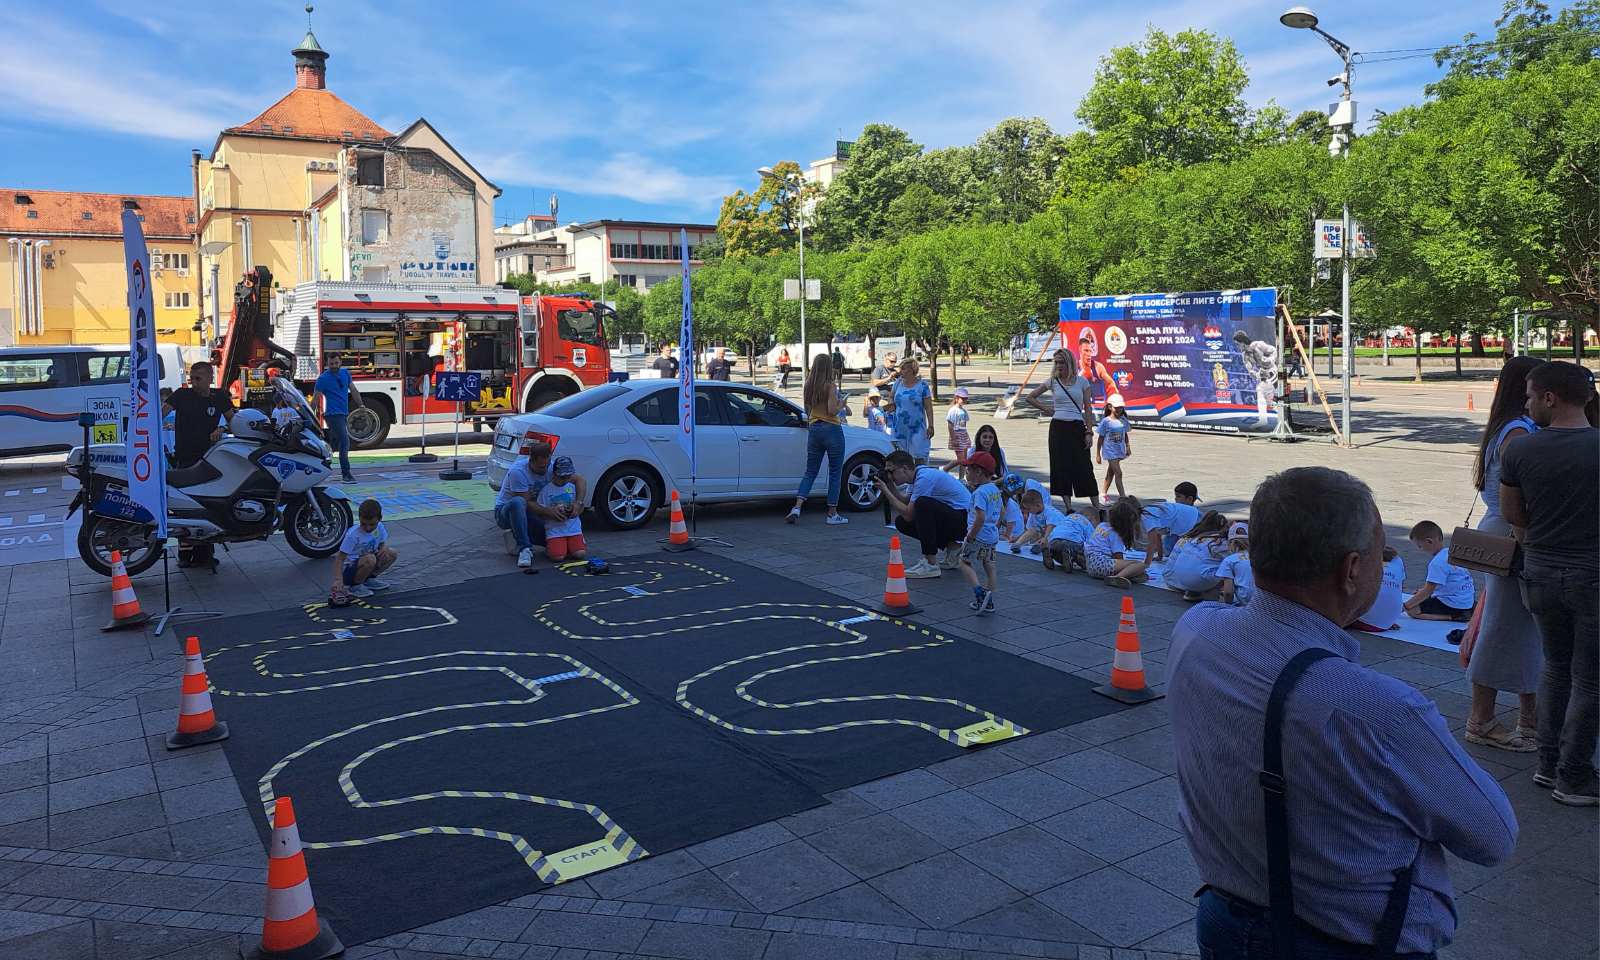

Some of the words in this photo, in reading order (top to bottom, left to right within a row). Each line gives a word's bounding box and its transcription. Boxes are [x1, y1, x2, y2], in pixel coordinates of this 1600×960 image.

[1113, 299, 1143, 308] ФИНАЛЕ
[1145, 297, 1191, 306] БОКСЕРСКЕ
[1193, 296, 1215, 304] ЛИГЕ
[1217, 295, 1252, 303] СРБИЈЕ
[1136, 327, 1161, 335] БАЊА
[1163, 326, 1186, 334] ЛУКА
[1157, 336, 1173, 344] ЈУН
[1175, 336, 1196, 344] 2024
[93, 401, 115, 410] ЗОНА
[95, 411, 119, 421] КОЛЕ
[965, 726, 996, 738] СТАРТ
[560, 845, 609, 864] СТАРТ
